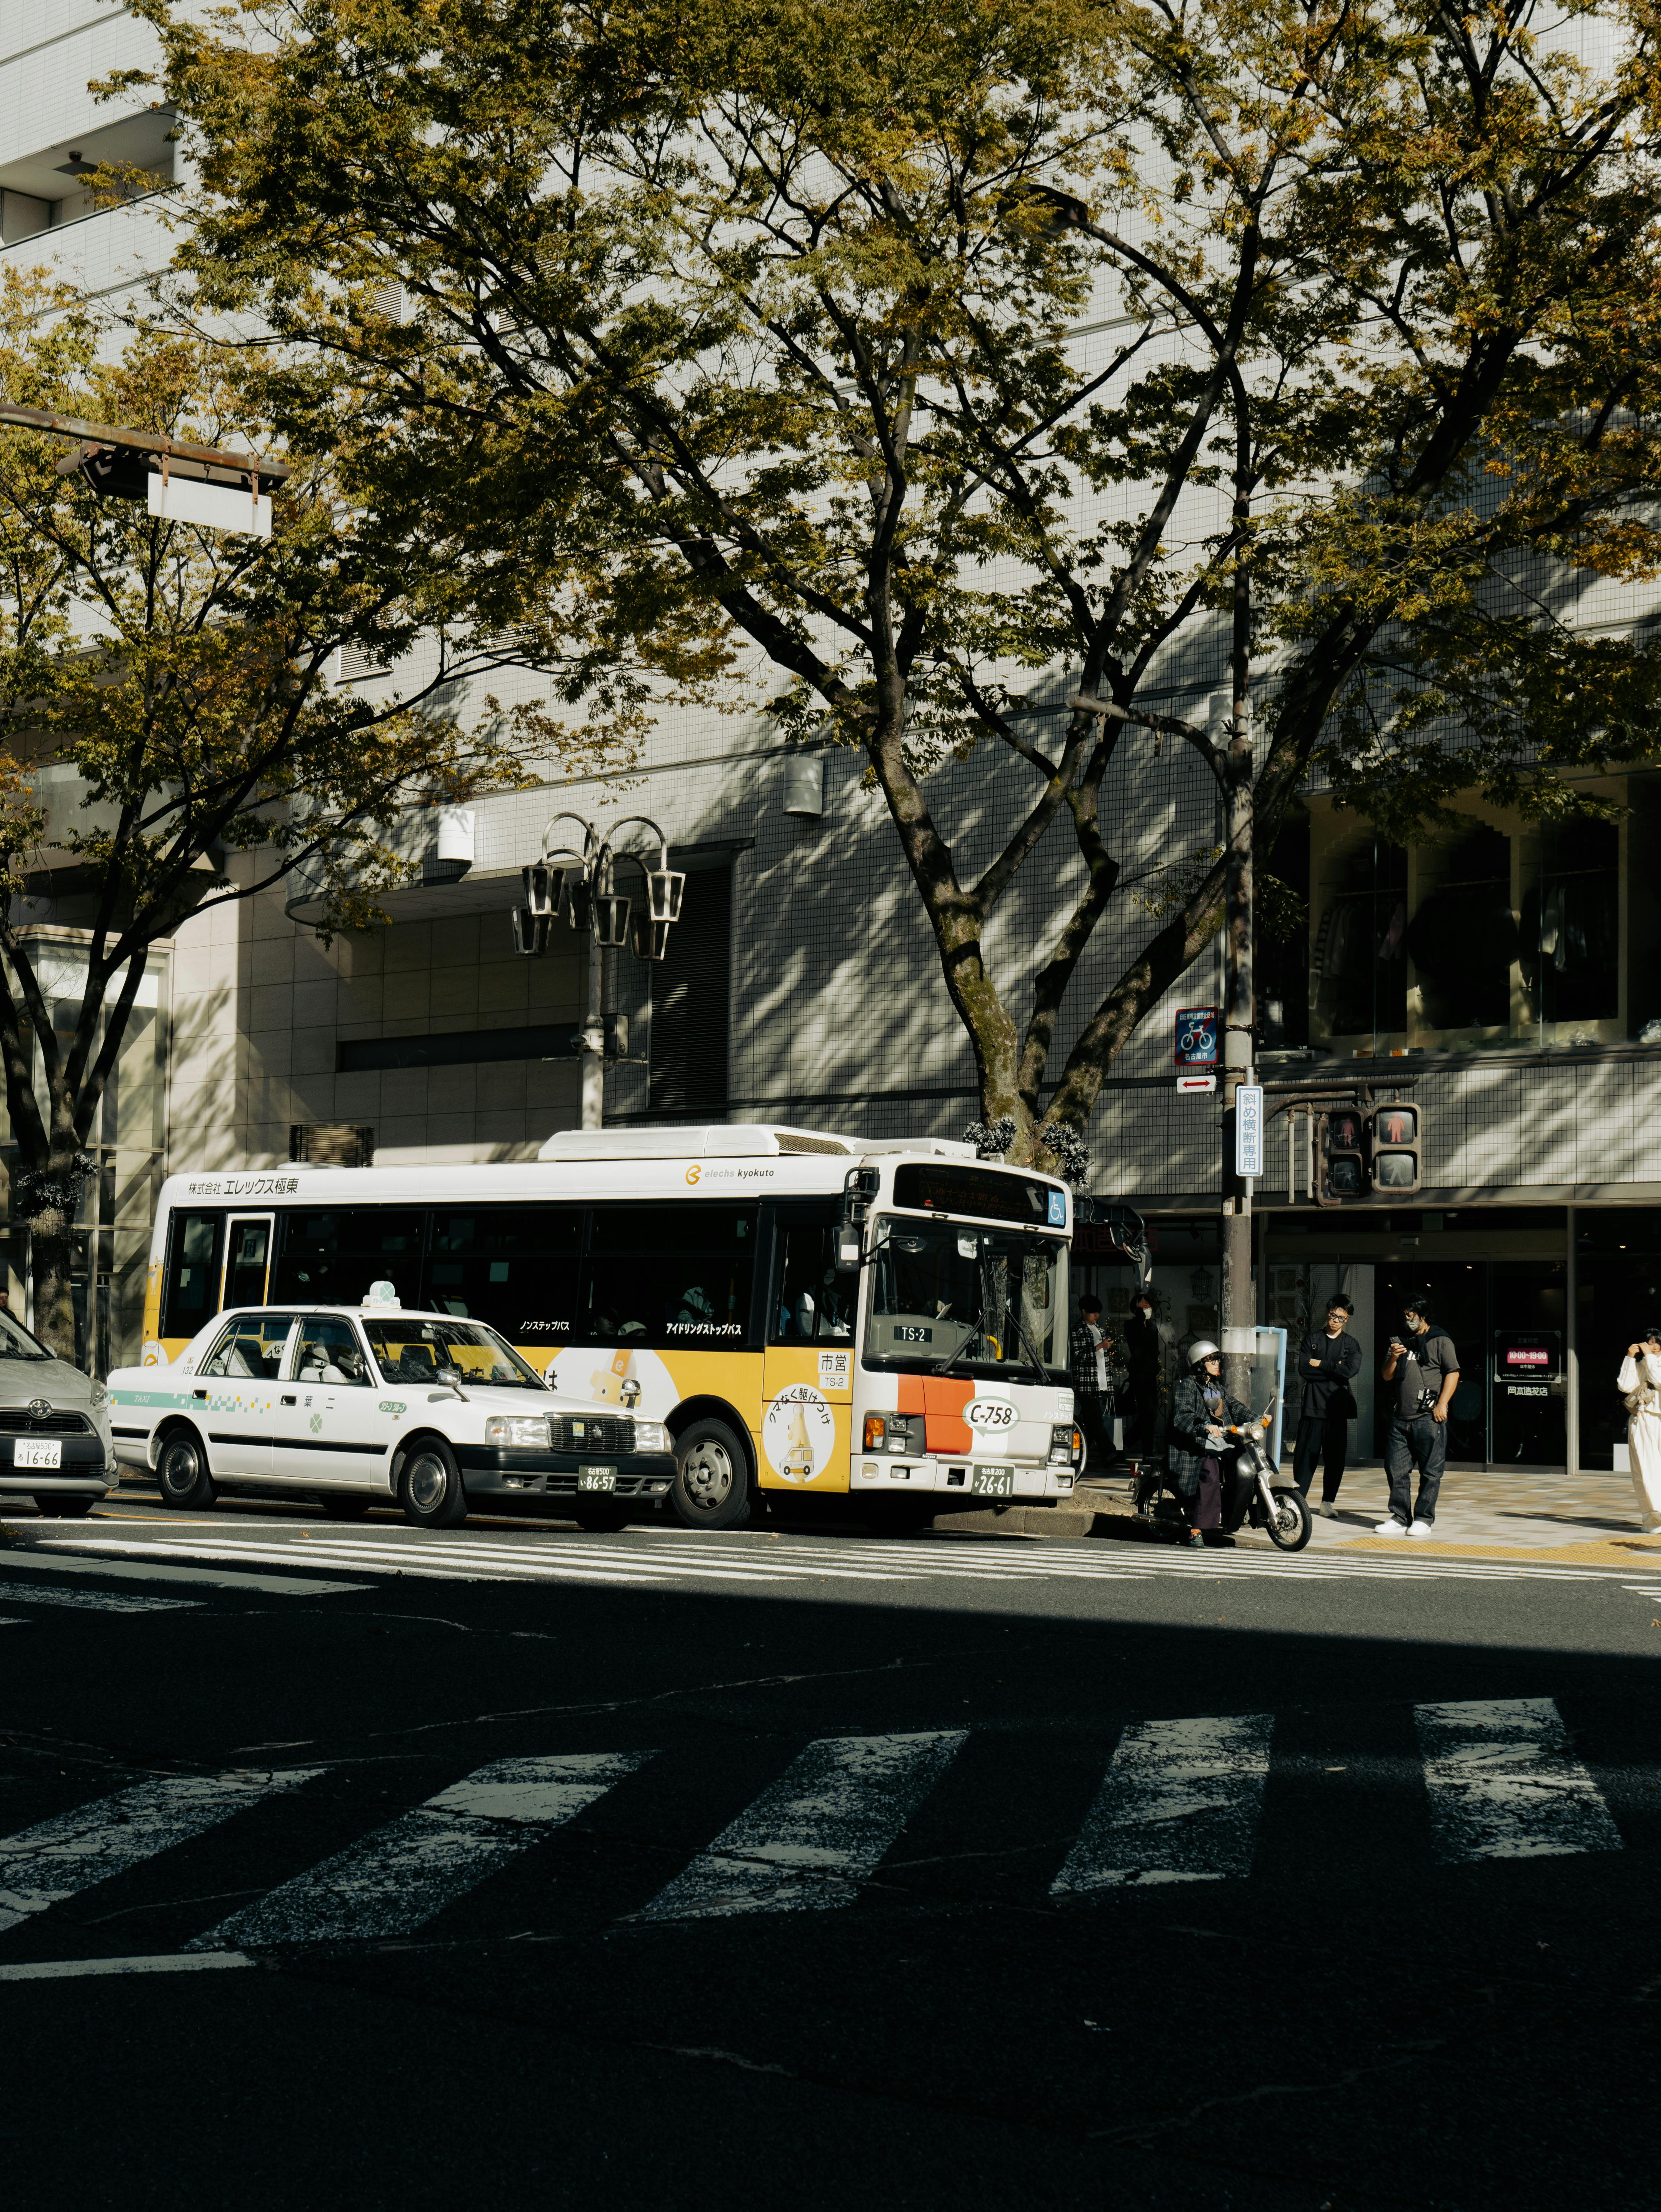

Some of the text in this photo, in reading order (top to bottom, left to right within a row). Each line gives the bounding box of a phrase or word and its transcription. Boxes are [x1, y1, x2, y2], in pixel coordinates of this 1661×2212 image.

[1185, 1052, 1207, 1060] 名古屋市
[1243, 1093, 1256, 1170] 斜め横断専用
[705, 1169, 734, 1178] elechs
[737, 1169, 774, 1179] kyokuto
[188, 1178, 299, 1195] 株式会社 エレックス極東
[520, 1321, 570, 1330] ノンステップバス
[666, 1323, 741, 1335] アイドリングストップバス
[902, 1327, 925, 1342] TS-2
[182, 1366, 193, 1374] 132
[822, 1354, 846, 1372] 市営
[825, 1378, 844, 1386] TS-2
[1507, 1386, 1548, 1396] 岡本造花店
[769, 1388, 830, 1424] クマなく駆けつけ
[970, 1405, 1012, 1425] C-758
[27, 1451, 58, 1465] 16-66
[981, 1468, 1005, 1476] 名古屋200
[586, 1476, 615, 1490] 86-57
[979, 1475, 1010, 1495] 26-61
